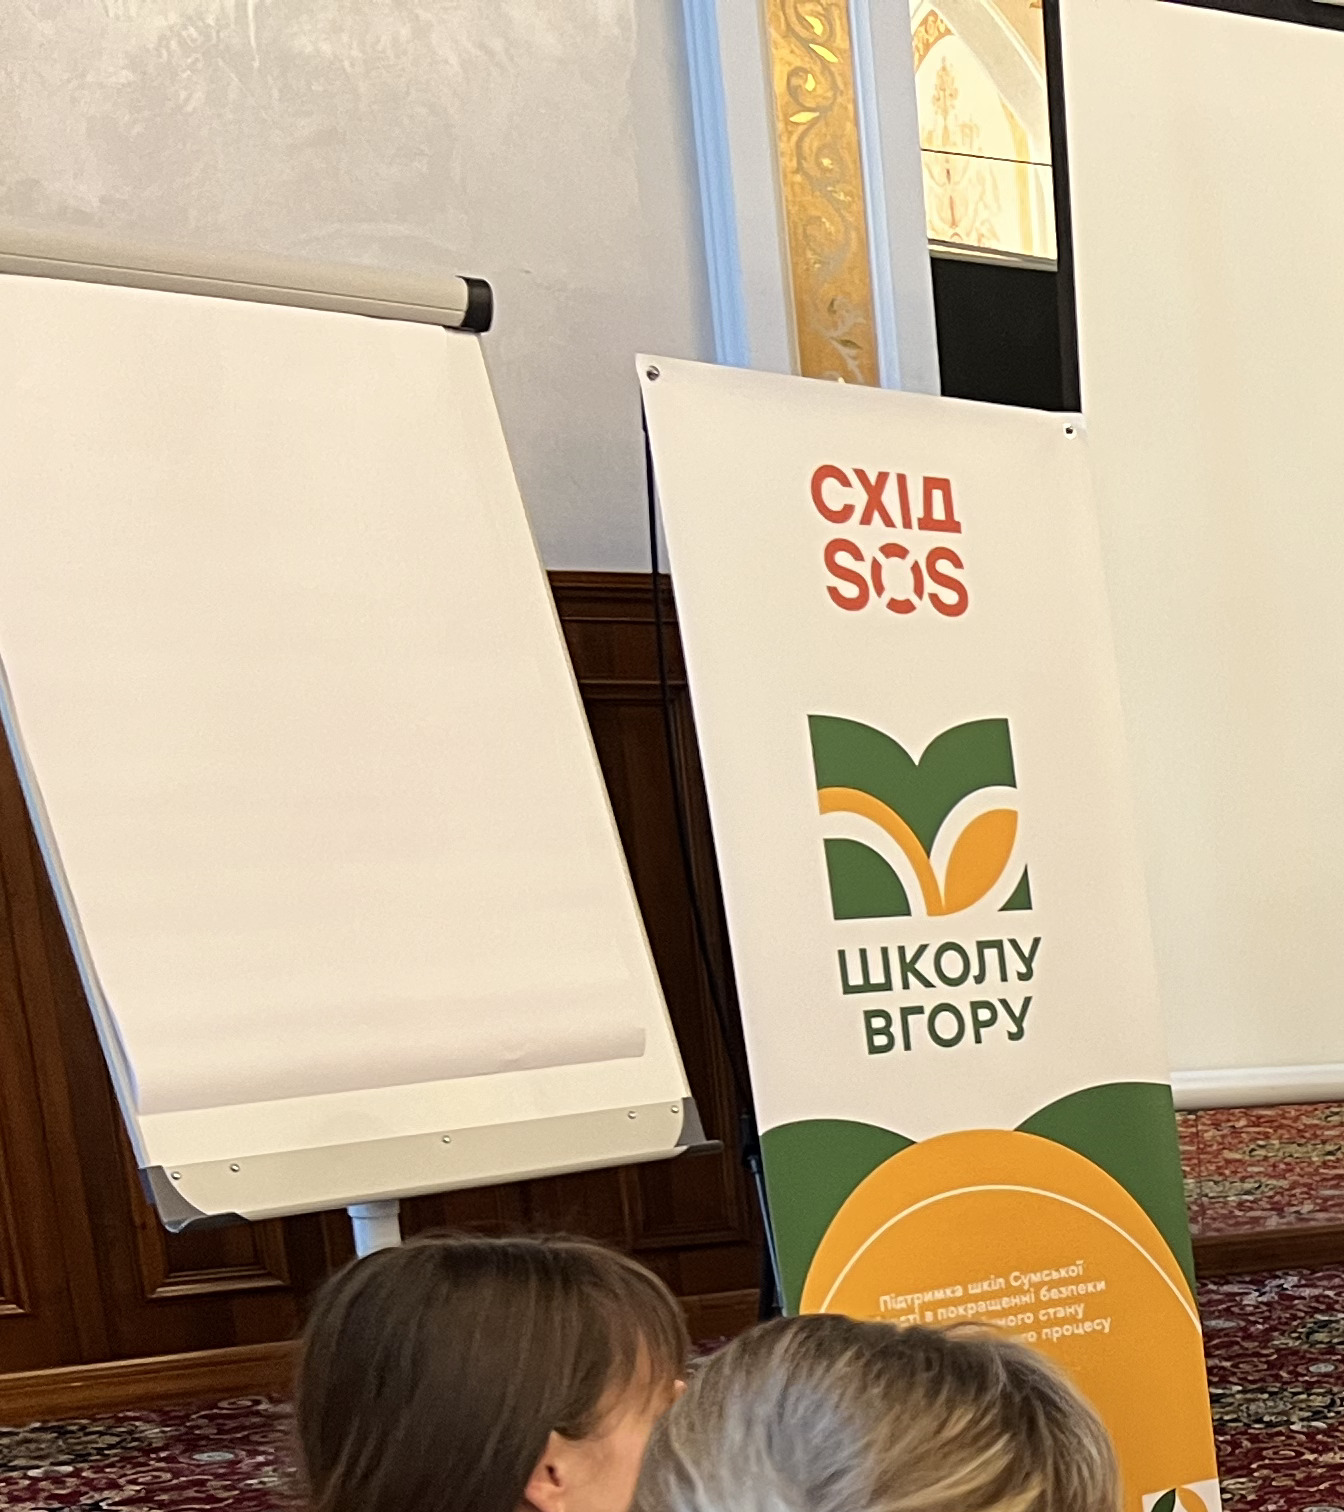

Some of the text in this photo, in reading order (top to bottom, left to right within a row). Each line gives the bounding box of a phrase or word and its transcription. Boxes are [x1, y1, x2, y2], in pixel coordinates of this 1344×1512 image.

[811, 464, 962, 534] СХІД
[823, 538, 969, 618] SOS
[837, 937, 1042, 995] ШКОЛУ
[863, 996, 1033, 1056] ВГОРУ
[879, 1260, 1085, 1314] Підтримка шкіл Сумської
[937, 1287, 1036, 1322] покращенні
[1040, 1279, 1107, 1302] безпеки
[1038, 1302, 1085, 1321] стану
[1041, 1316, 1112, 1343] процесу
